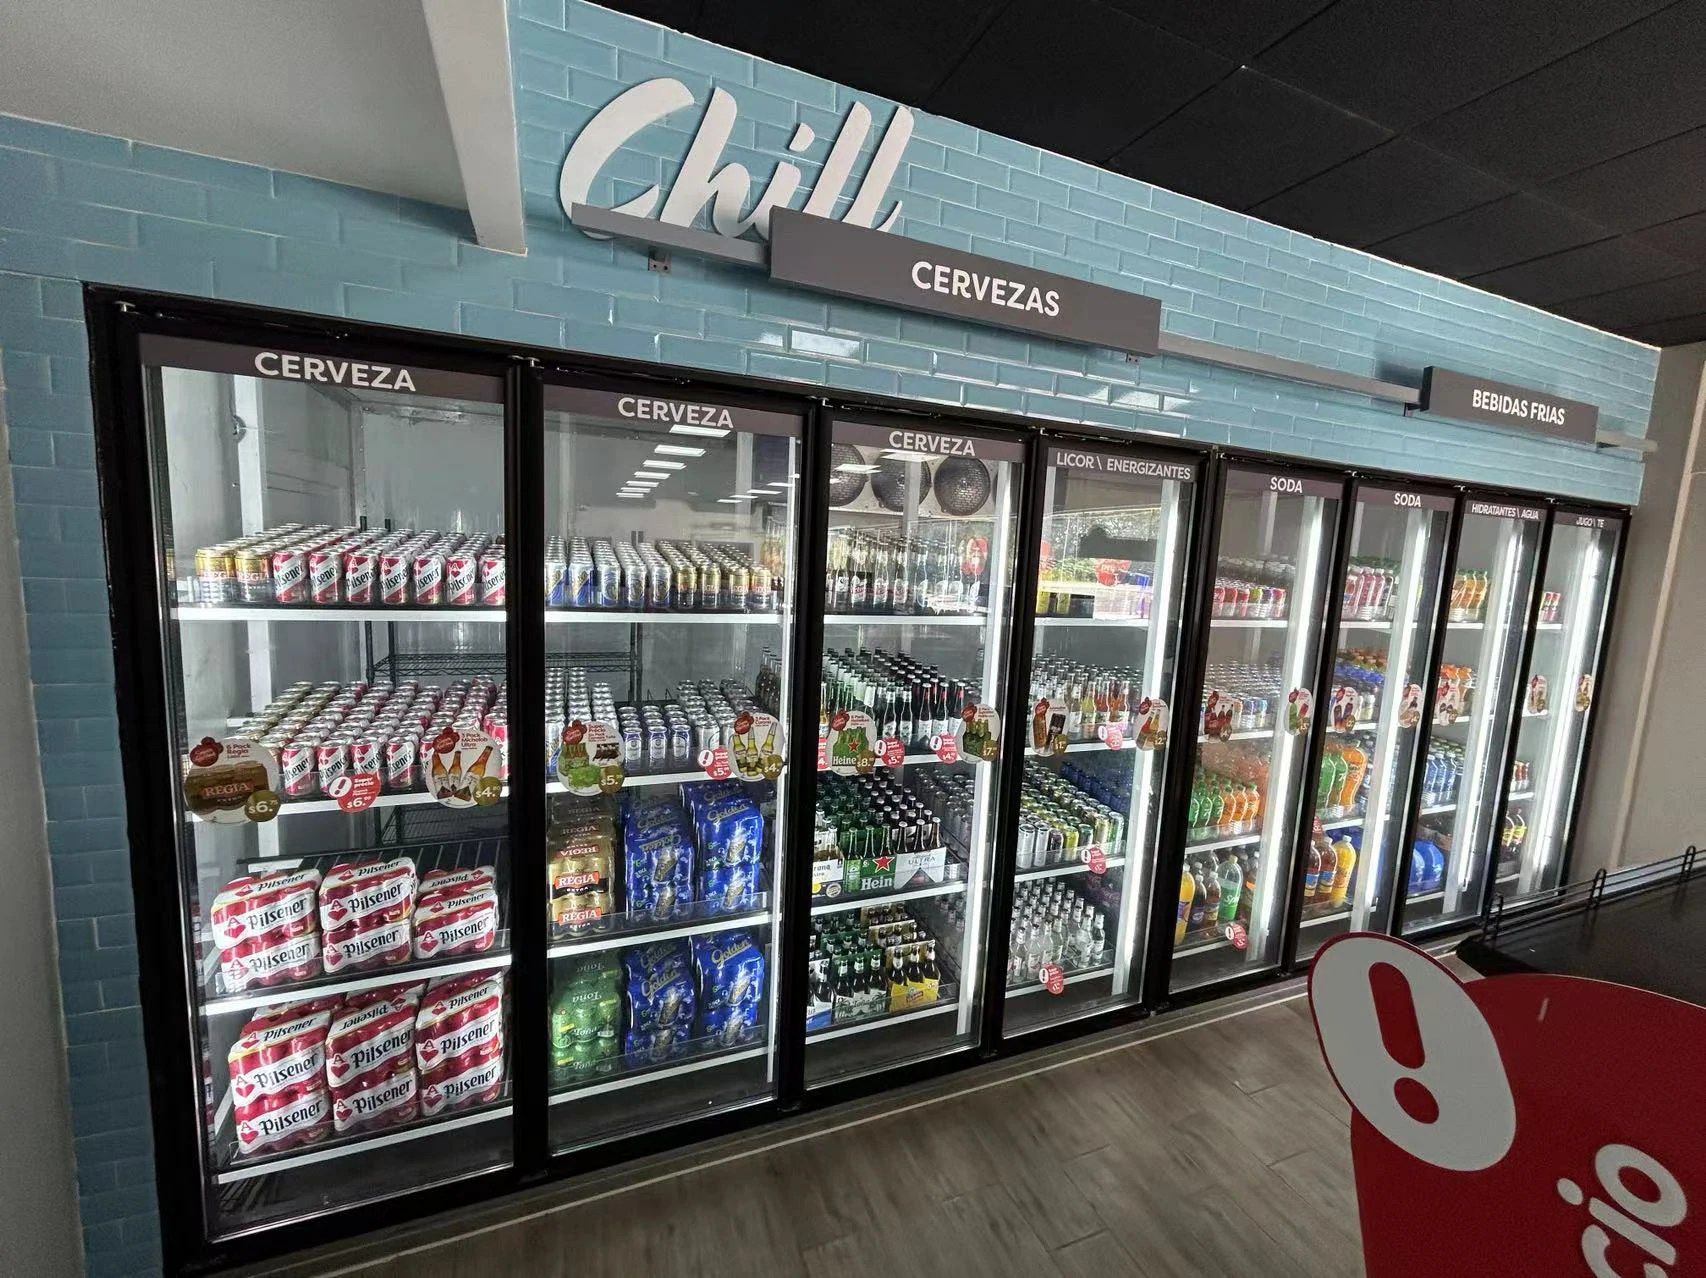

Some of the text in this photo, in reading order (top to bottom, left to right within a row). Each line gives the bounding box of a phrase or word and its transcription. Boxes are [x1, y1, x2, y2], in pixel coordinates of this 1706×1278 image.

[560, 78, 914, 240] Chill
[911, 261, 1062, 318] CERVEZAS
[254, 351, 417, 392] CERVEZA
[617, 396, 734, 430] CERVEZA
[1472, 389, 1565, 426] BEBIDAS FRIAS
[888, 430, 976, 458] CERVEZA
[1056, 452, 1095, 470] LICOR
[1107, 458, 1191, 480] ENERGIZANTES
[1270, 476, 1303, 494] SODA
[1394, 492, 1422, 508] SODA
[1471, 503, 1516, 518] HIDRATANTES
[1521, 509, 1540, 520] AGUA
[204, 782, 250, 797] REGIA
[706, 804, 751, 825] Golden
[258, 874, 305, 891] Pilsener
[358, 861, 400, 876] Pilsener
[559, 874, 595, 886] REGIA
[348, 882, 403, 913] Pilsener
[860, 877, 893, 891] Hein
[247, 898, 307, 930] Pilsener
[447, 893, 487, 908] Pilsener
[562, 910, 598, 922] REGIA
[342, 929, 399, 959] Pilsener
[439, 917, 490, 945] Pilsener
[248, 943, 310, 972] Pilsener
[711, 940, 753, 966] Golden
[449, 987, 489, 1009] Pilsener
[263, 1017, 317, 1042] Pilsener
[440, 1020, 495, 1054] Pilsener
[351, 1028, 414, 1069] Pilsener
[254, 1053, 318, 1088] Pilsener
[443, 1066, 497, 1099] Pilsener
[352, 1079, 413, 1114] Pilsener
[259, 1100, 323, 1136] Pilsener
